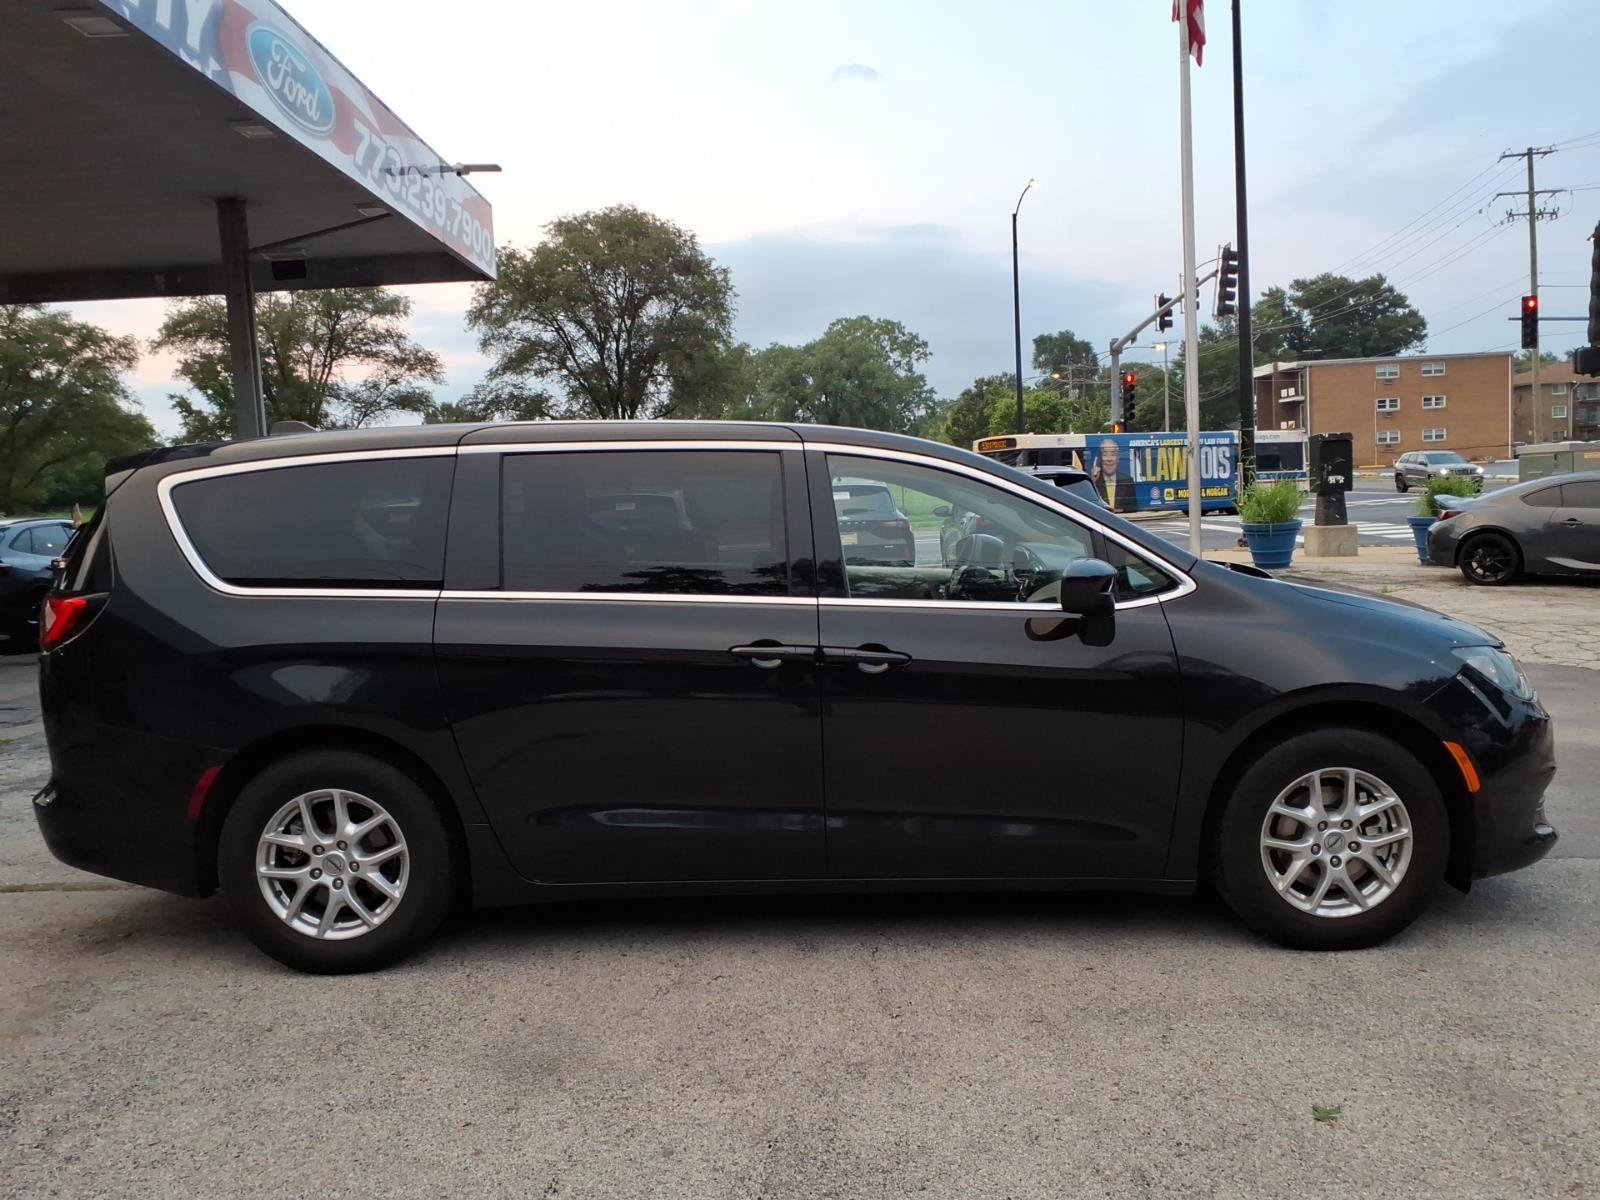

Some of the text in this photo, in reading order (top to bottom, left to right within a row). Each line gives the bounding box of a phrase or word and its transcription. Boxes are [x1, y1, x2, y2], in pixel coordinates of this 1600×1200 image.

[267, 39, 320, 121] Ford
[353, 117, 491, 261] 773.239.7900
[1129, 439, 1159, 447] AMERICA'S
[1159, 438, 1183, 446] LARGEST
[1129, 447, 1231, 482] ILLAWOIS
[1206, 488, 1229, 497] MORGAN
